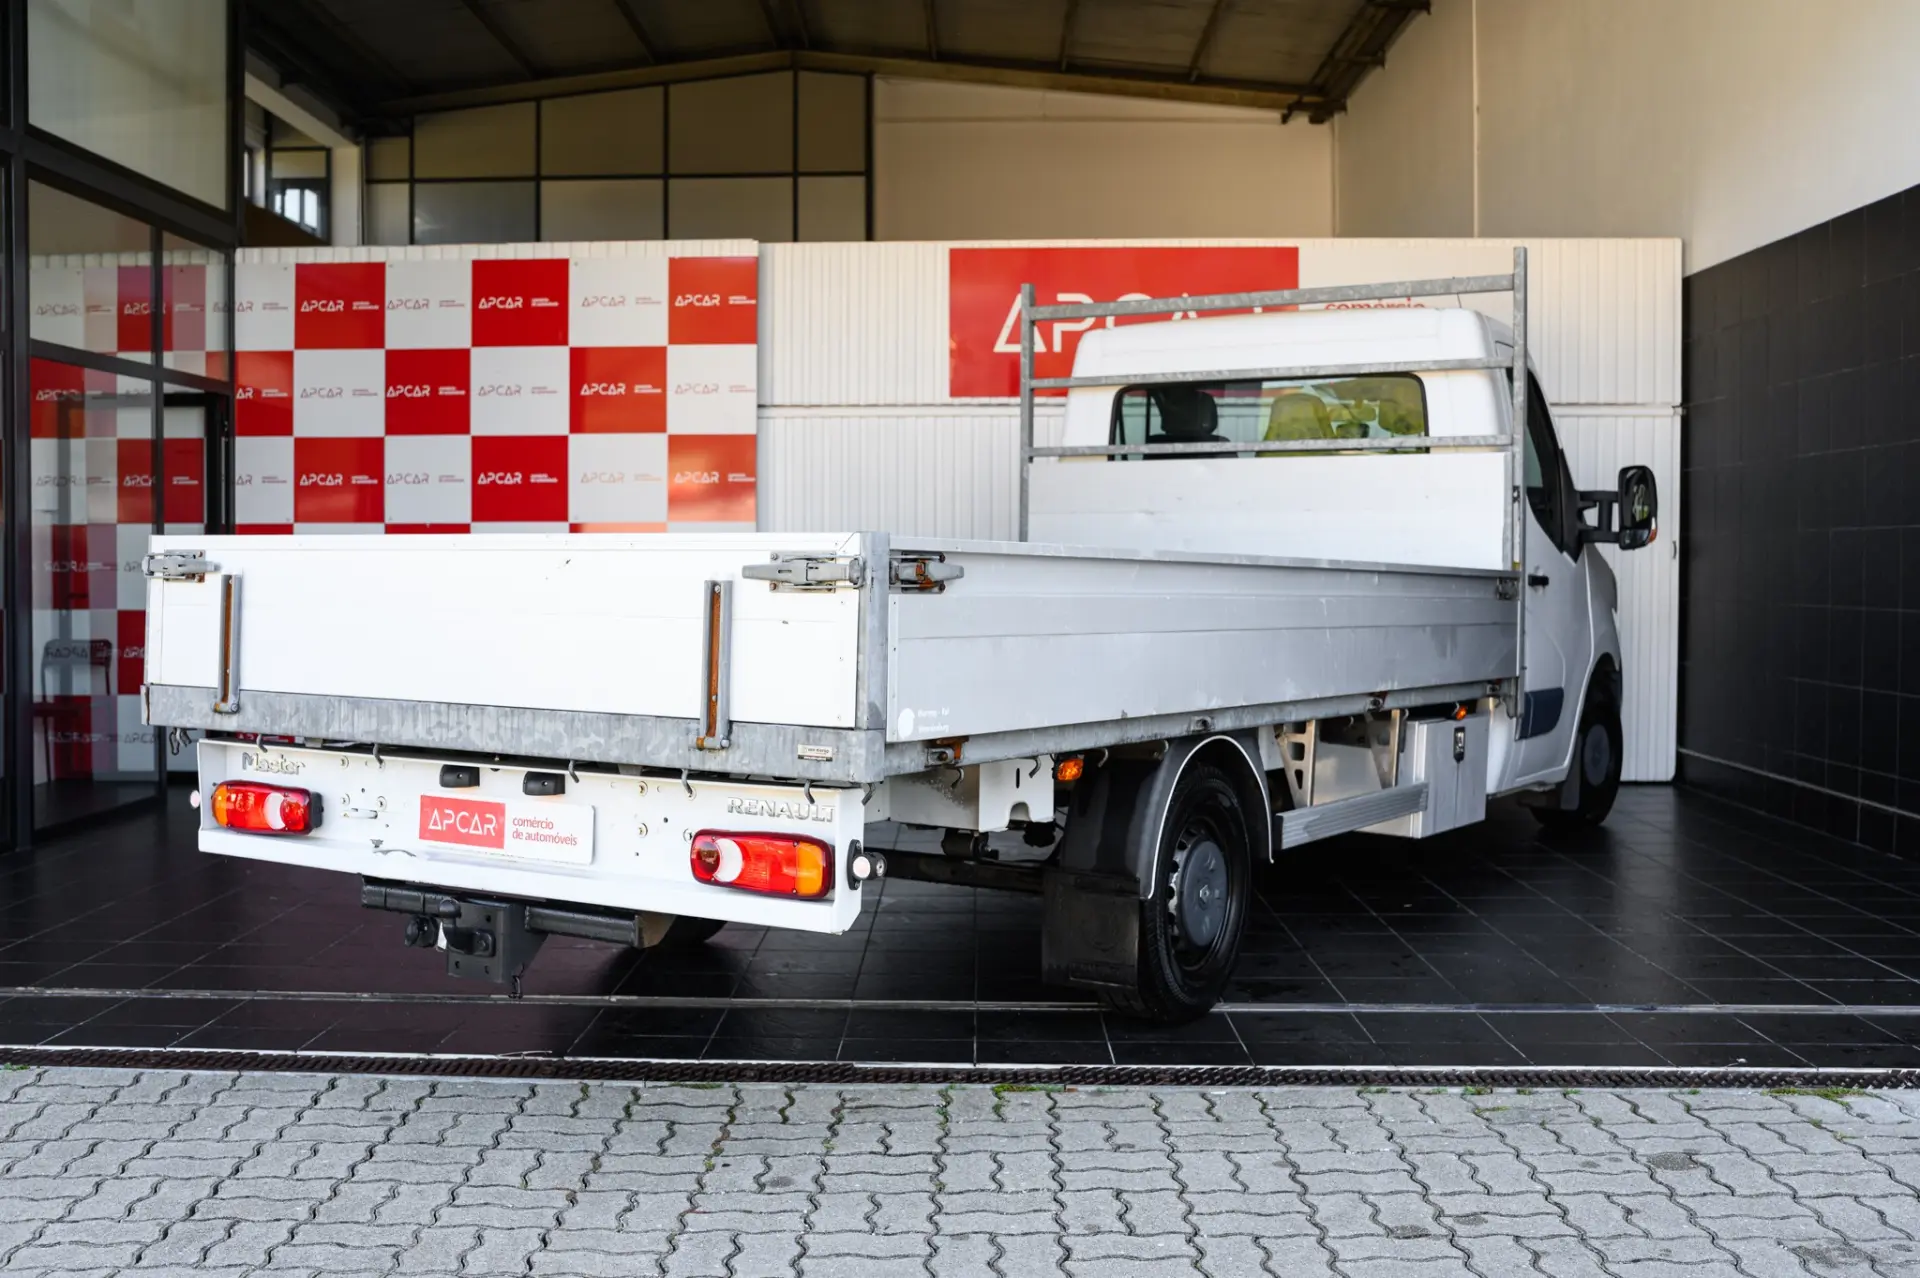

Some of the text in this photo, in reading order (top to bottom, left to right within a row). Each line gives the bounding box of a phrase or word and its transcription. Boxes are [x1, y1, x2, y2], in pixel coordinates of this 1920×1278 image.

[300, 300, 345, 312] APCAR
[386, 299, 430, 310] APCAR
[478, 297, 523, 309] APCAR
[581, 296, 626, 307] APCAR
[674, 294, 720, 307] APCAR
[300, 387, 344, 399] APCAR
[386, 385, 431, 397] APCAR
[478, 385, 522, 396] APCAR
[580, 383, 626, 395] APCAR
[674, 383, 720, 395] APCAR
[299, 473, 344, 486] APCAR
[386, 473, 430, 484] APCAR
[477, 472, 522, 484] APCAR
[580, 472, 625, 484] APCAR
[674, 472, 720, 484] APCAR
[242, 752, 306, 775] Master
[727, 797, 836, 822] RENAULT
[428, 808, 496, 836] APCAR
[512, 815, 554, 830] comércio
[512, 830, 578, 846] de automóveis
